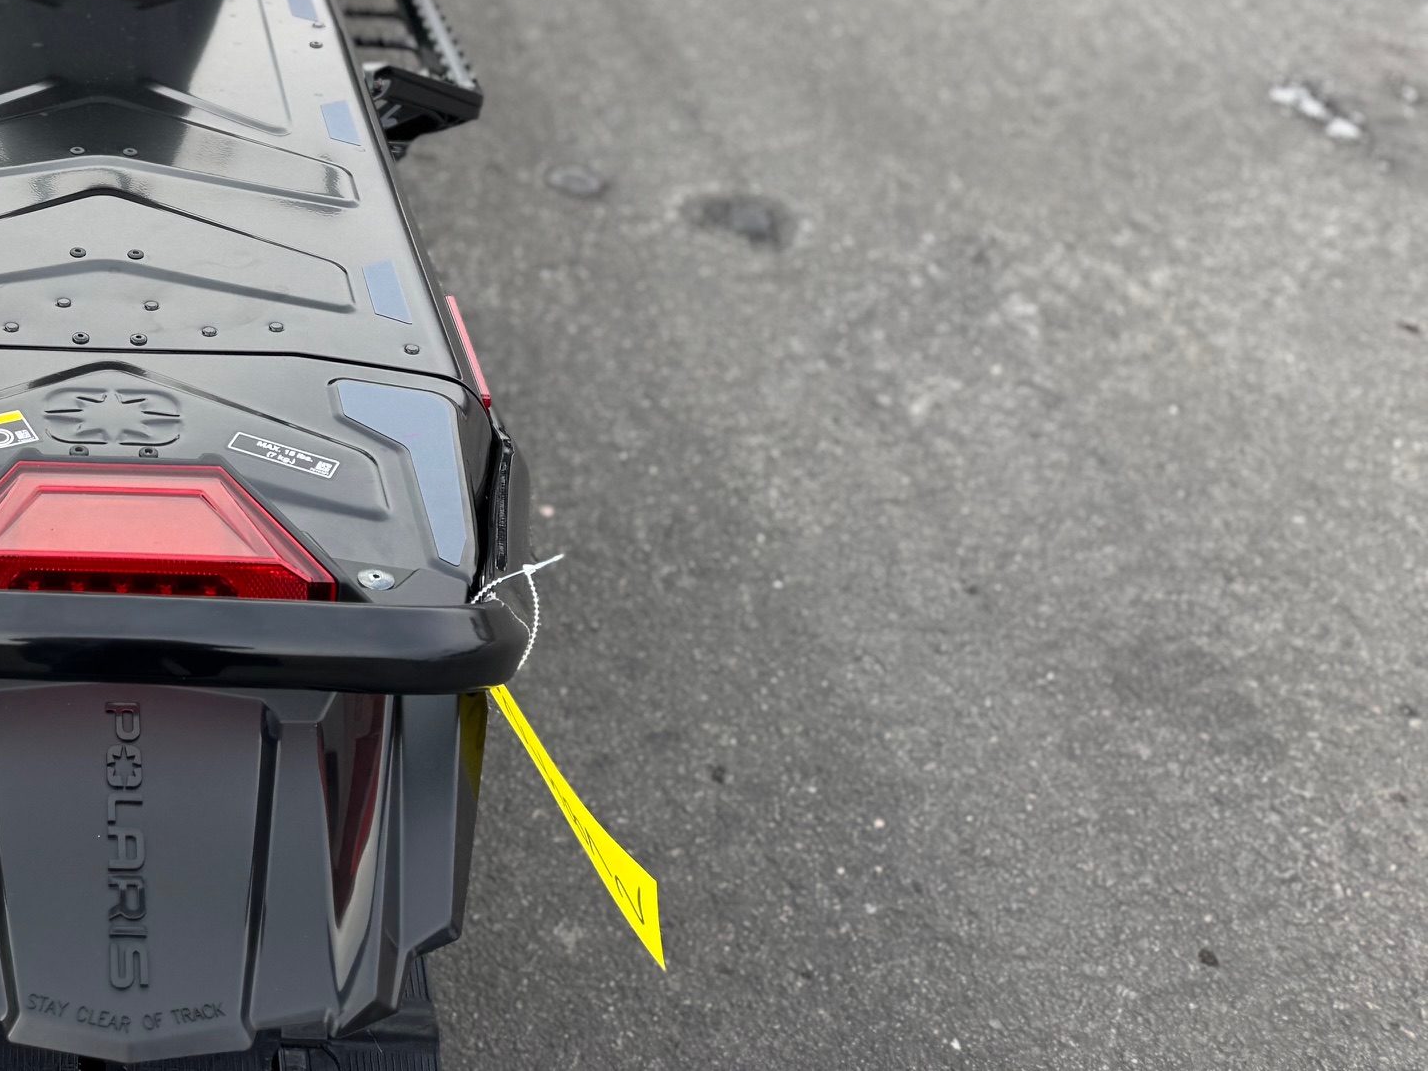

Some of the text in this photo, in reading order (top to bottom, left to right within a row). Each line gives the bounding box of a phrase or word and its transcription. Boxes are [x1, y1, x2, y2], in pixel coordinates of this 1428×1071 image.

[256, 441, 281, 453] MAX.
[105, 701, 149, 991] POLARIS
[25, 993, 227, 1033] STAY CLEAR OF TRACK
